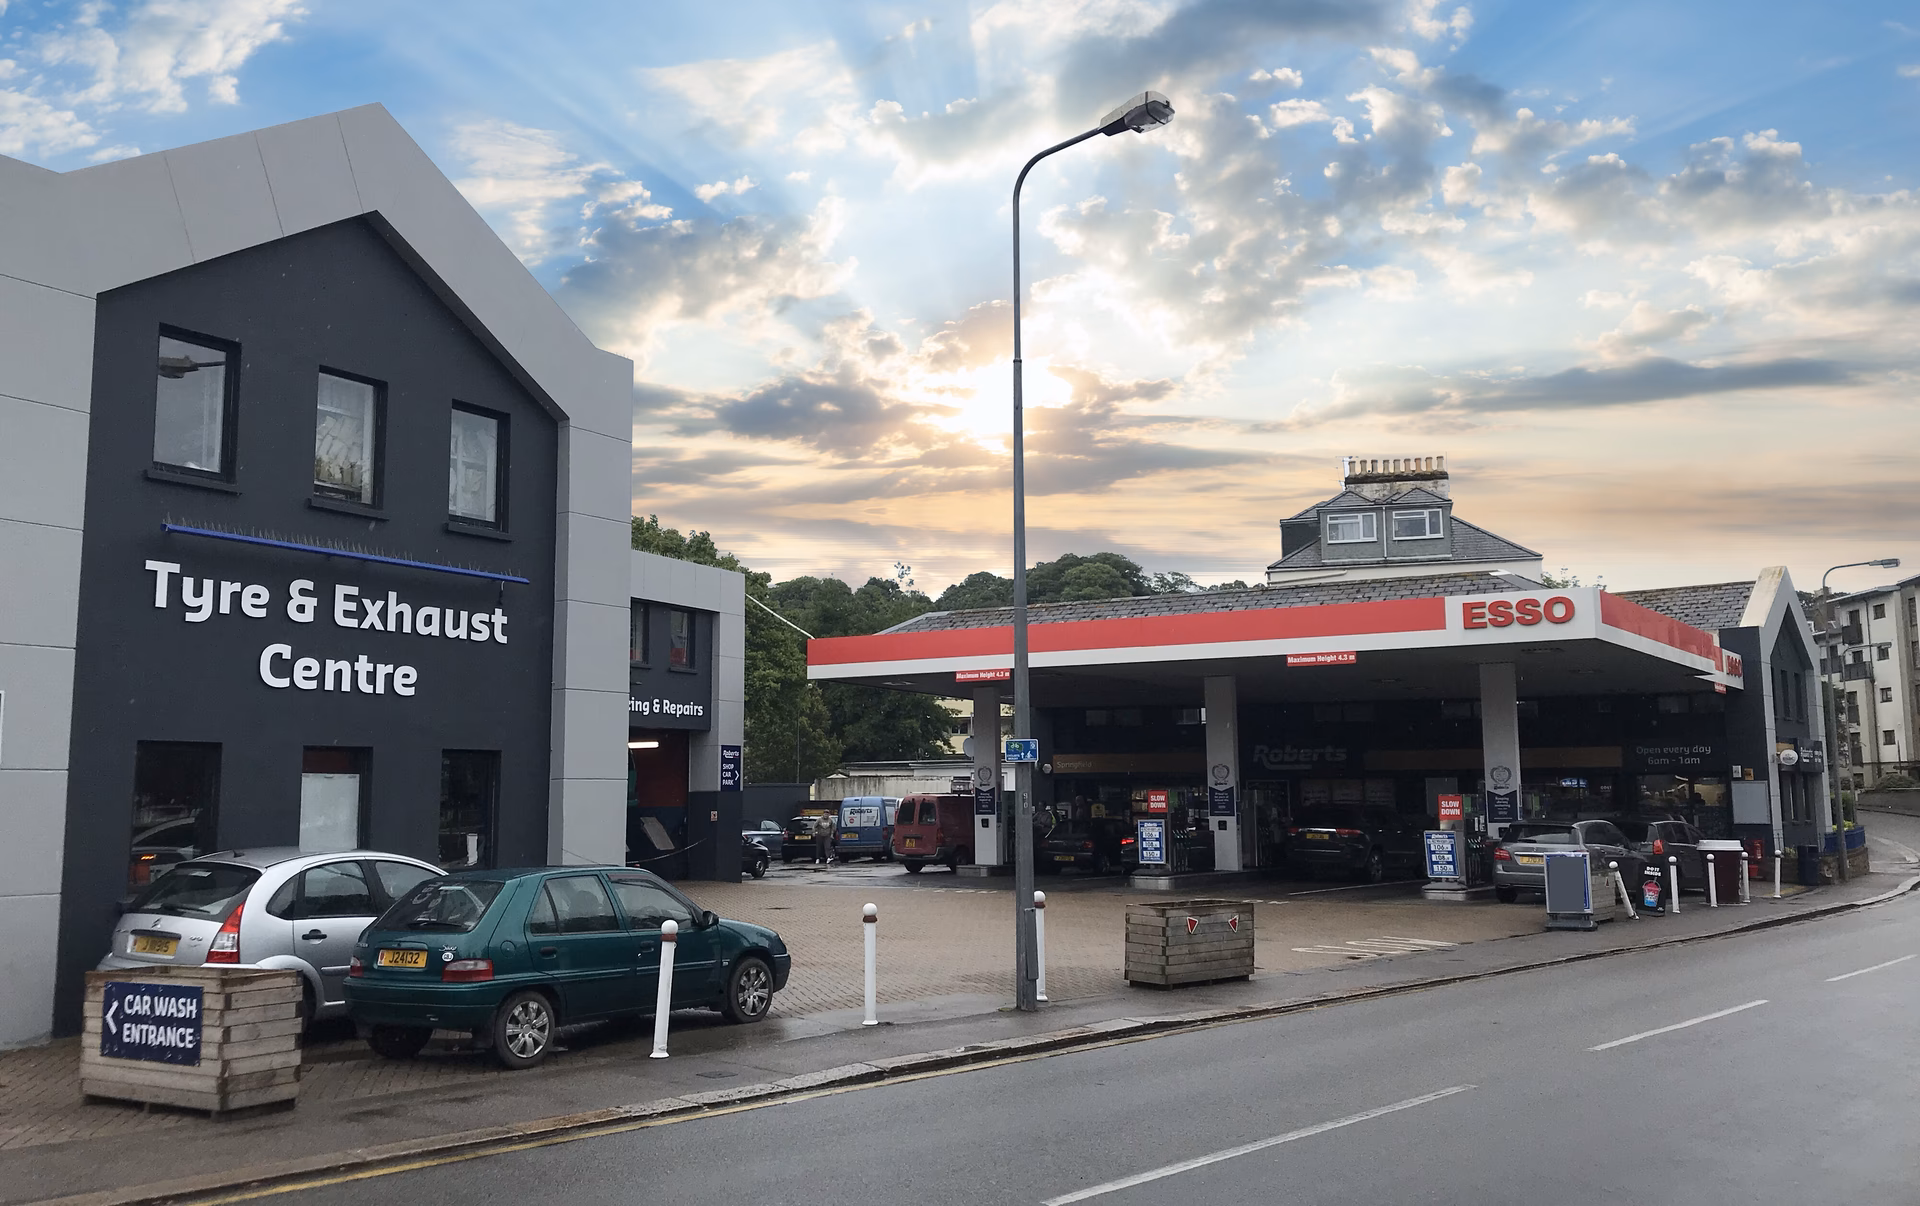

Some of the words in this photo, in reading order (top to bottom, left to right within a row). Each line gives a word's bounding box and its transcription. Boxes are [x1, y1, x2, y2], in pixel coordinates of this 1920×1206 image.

[145, 559, 270, 622] Tyre
[286, 579, 318, 623] &
[334, 584, 508, 644] Exhaust
[1462, 596, 1575, 629] ESSO
[259, 643, 418, 696] Centre
[653, 698, 660, 713] &
[663, 699, 704, 718] Repairs
[1253, 745, 1347, 768] Roberts
[1636, 746, 1661, 755] Open
[1663, 747, 1690, 755] every
[1692, 745, 1712, 754] day
[1679, 756, 1700, 764] 1am
[1056, 761, 1092, 770] Springfield
[1441, 808, 1460, 816] DOWN
[389, 951, 420, 964] J24132
[124, 994, 151, 1016] CAR
[154, 996, 198, 1019] WASH
[122, 1023, 196, 1049] ENTRANCE
